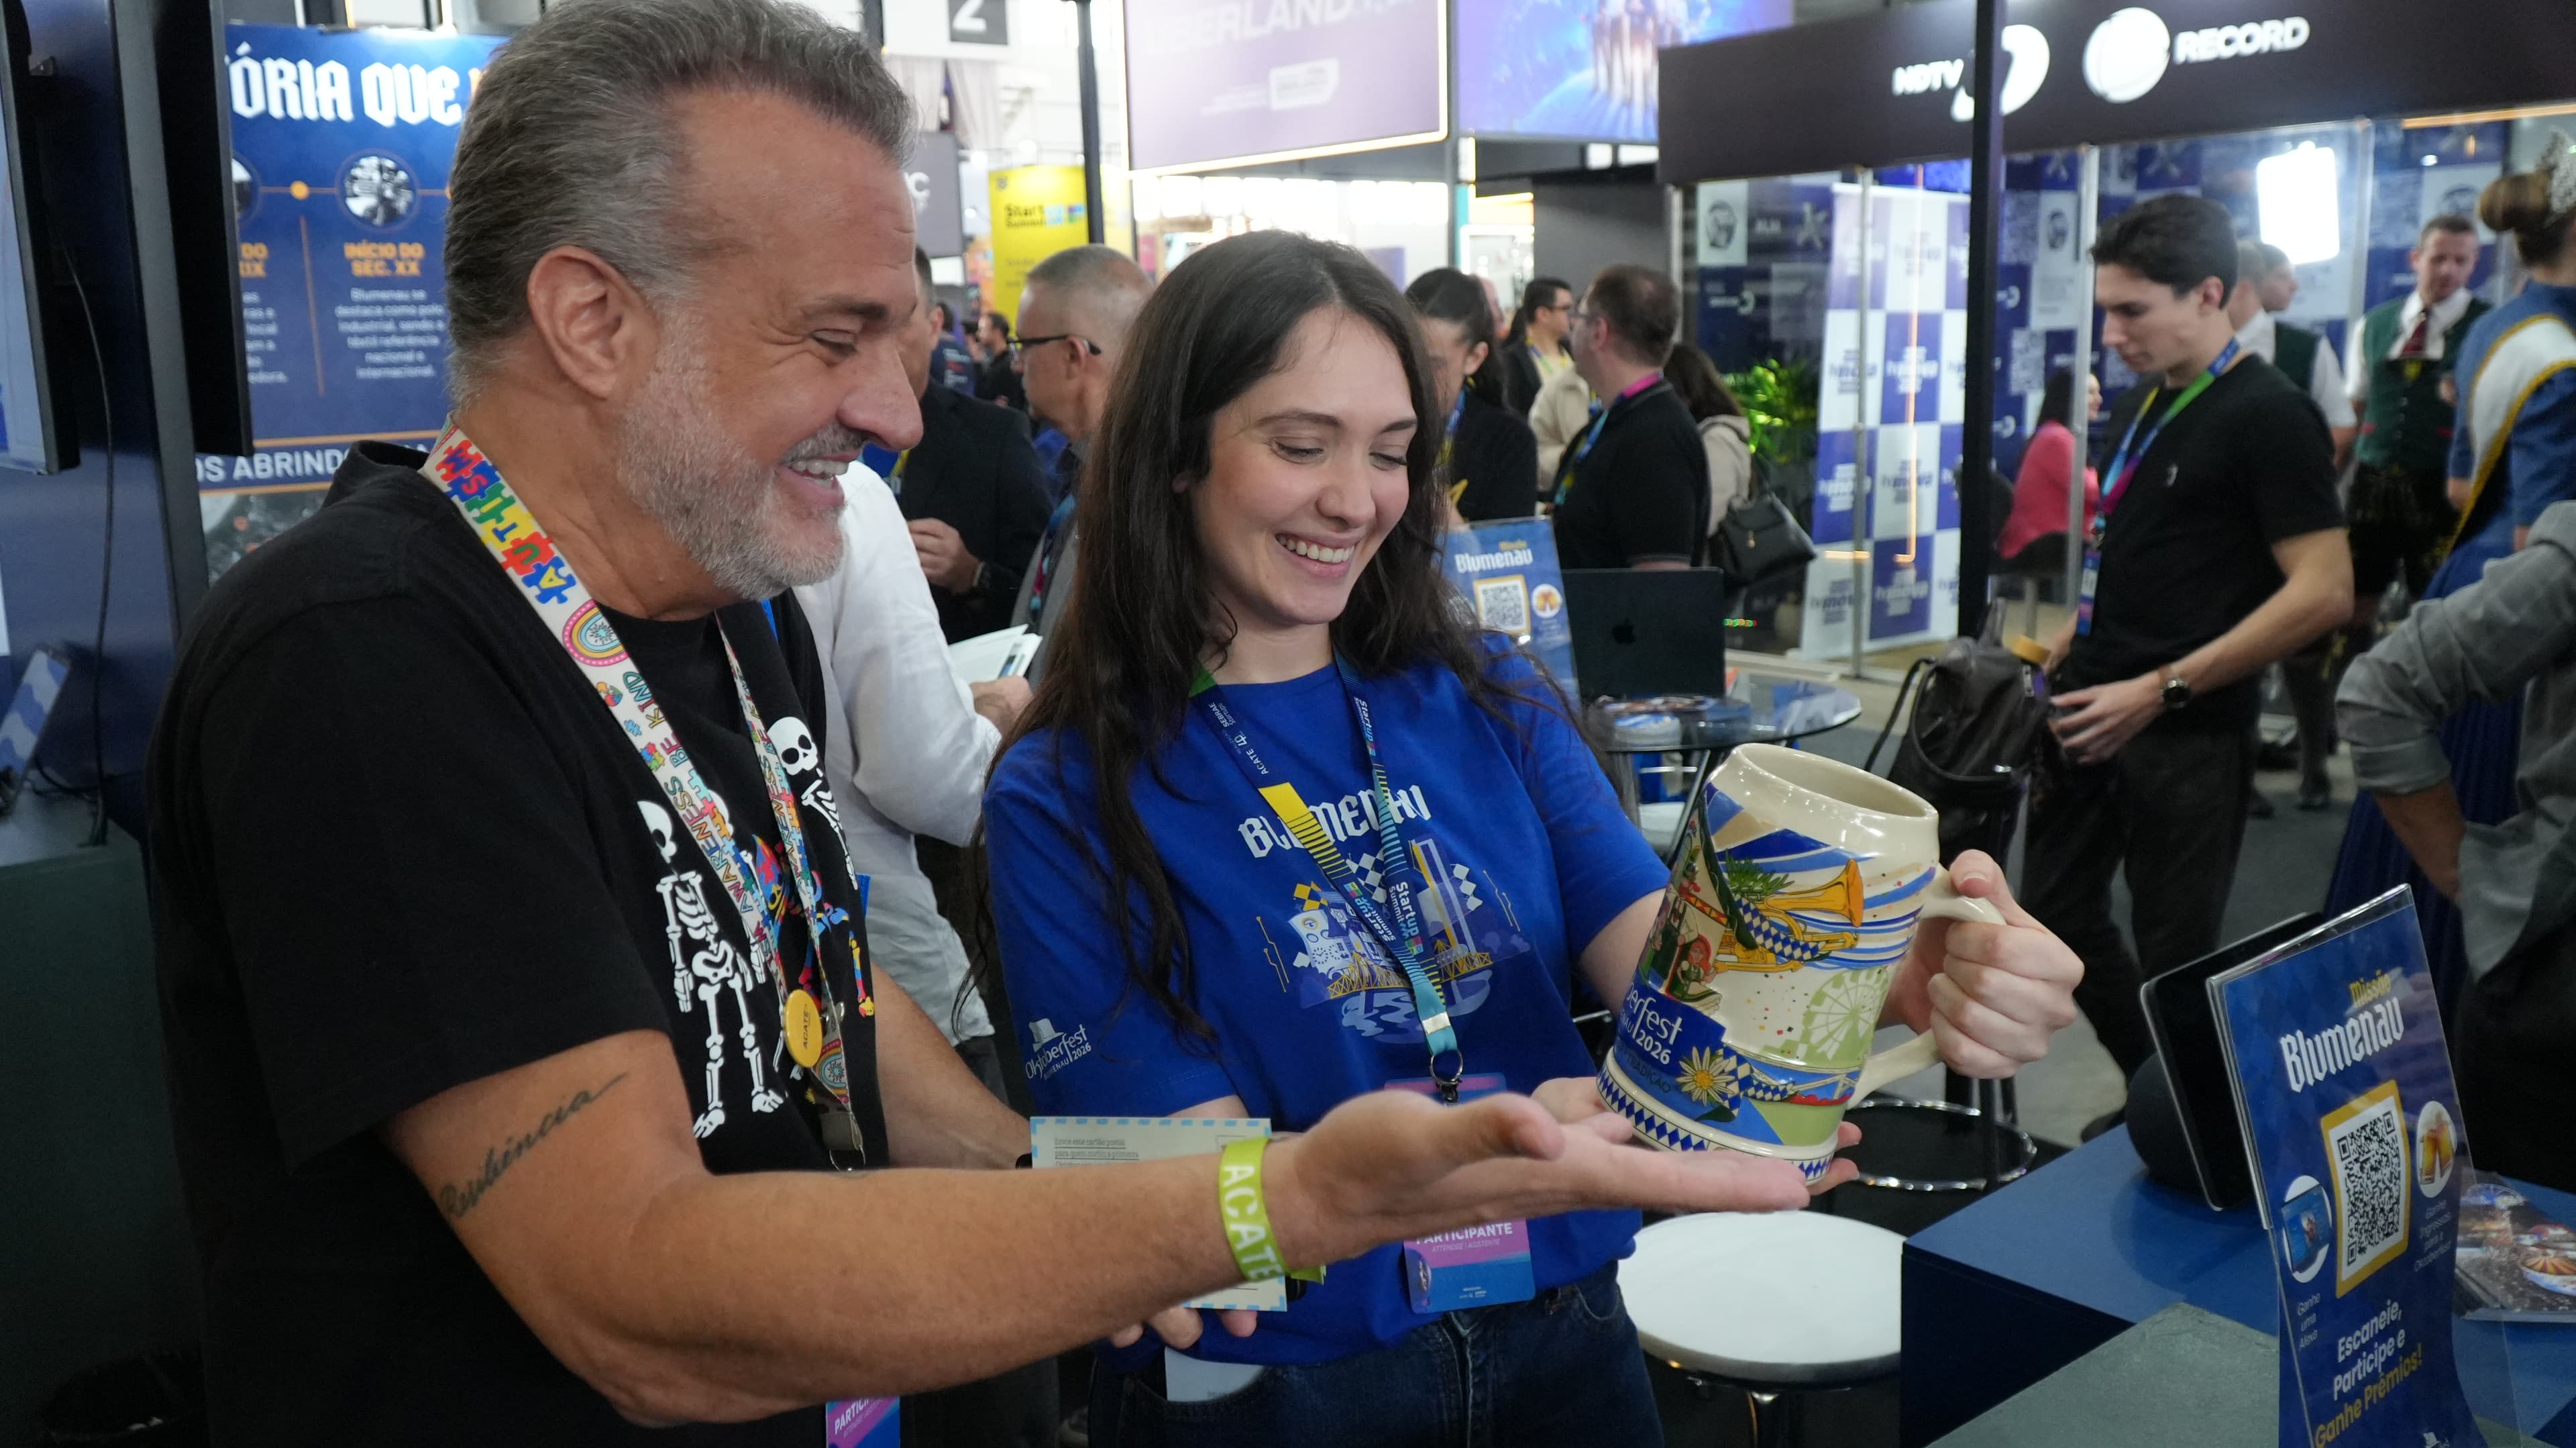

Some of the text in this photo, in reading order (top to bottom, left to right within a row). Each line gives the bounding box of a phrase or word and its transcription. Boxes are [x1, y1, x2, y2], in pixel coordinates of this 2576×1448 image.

[2174, 16, 2310, 64] RECORD
[225, 42, 354, 122] ÓRIA
[361, 62, 462, 127] QUE
[1893, 58, 1964, 95] NDTV
[343, 240, 425, 259] INÍCIO DO
[394, 259, 421, 277] XX
[233, 447, 349, 480] ABRIND
[444, 443, 570, 594] AUTISM
[1454, 548, 1533, 574] Blumenau
[623, 671, 688, 768] BE KIND
[1208, 702, 1229, 727] SEBRAE
[1359, 699, 1373, 741] Startup
[1246, 748, 1269, 774] ACATE
[664, 776, 753, 913] AWARENESS
[1355, 898, 1391, 941] Startup
[1371, 910, 1395, 941] Summit
[1389, 886, 1405, 923] Summit
[1396, 882, 1419, 936] Startup
[2349, 969, 2391, 1008] Missão
[1025, 1024, 1087, 1080] Oktoberfest
[1073, 1042, 1091, 1060] 2026
[1636, 1029, 1672, 1065] 2026
[2279, 996, 2404, 1093] Blumenau
[1224, 1164, 1284, 1280] ACATE
[2298, 1294, 2320, 1315] Ganhe
[2338, 1299, 2402, 1363] Escaneie,
[2334, 1329, 2406, 1401] Participe e
[2314, 1343, 2423, 1448] Ganhe Prêmios!
